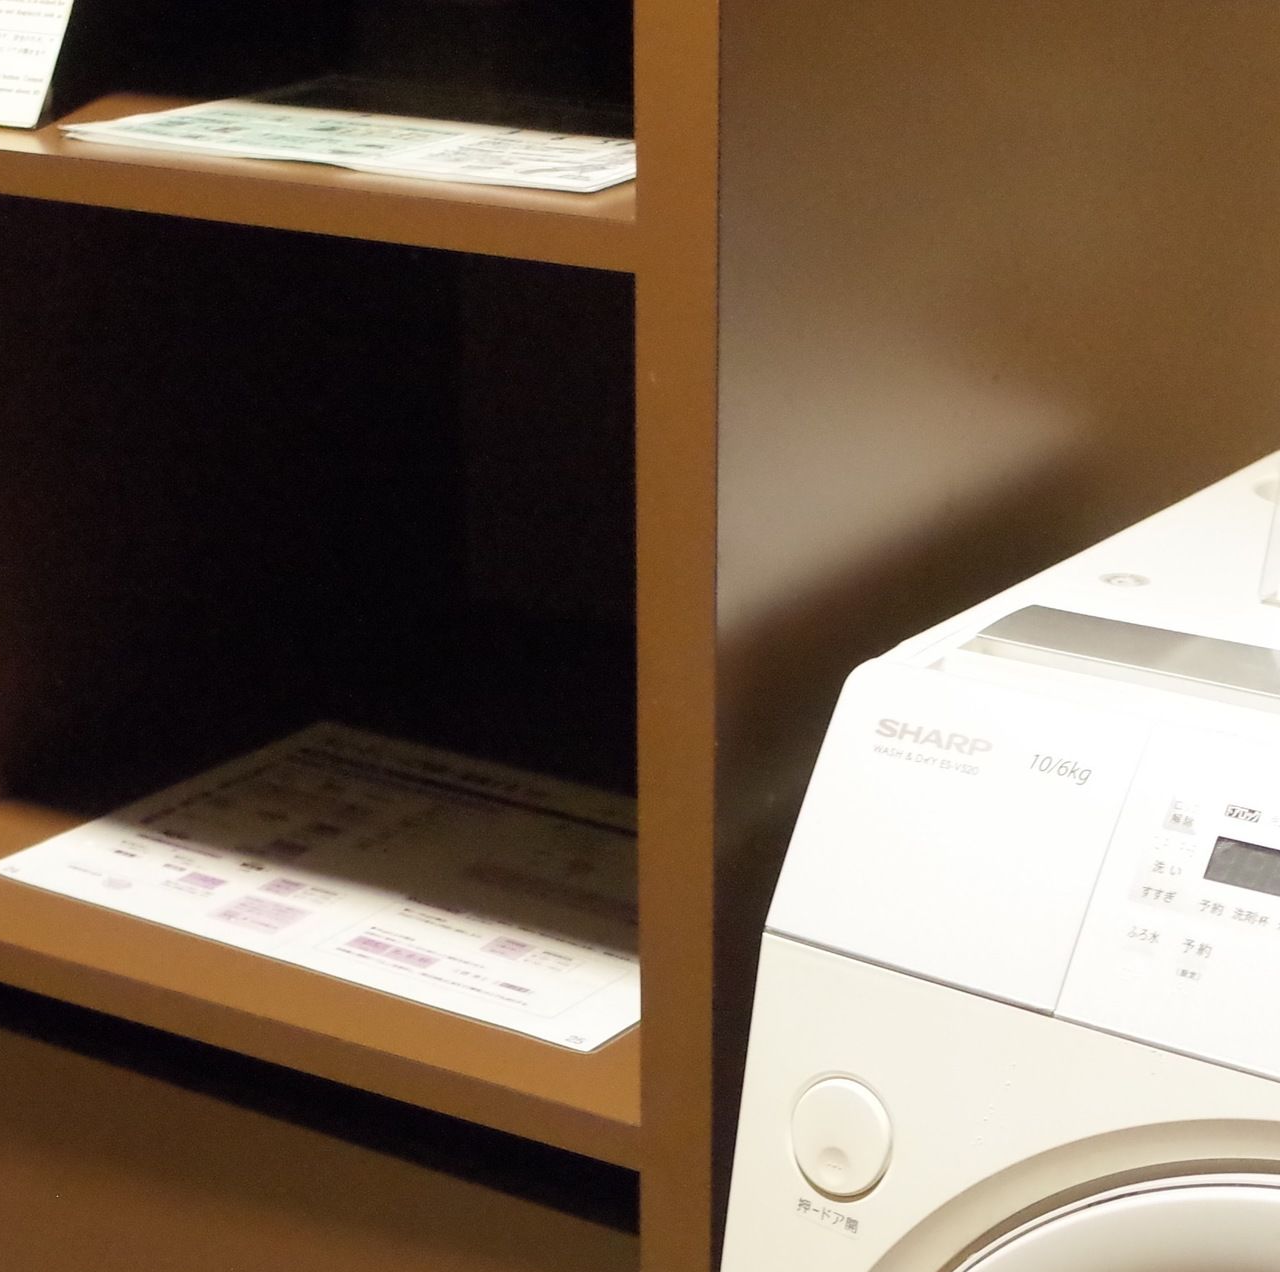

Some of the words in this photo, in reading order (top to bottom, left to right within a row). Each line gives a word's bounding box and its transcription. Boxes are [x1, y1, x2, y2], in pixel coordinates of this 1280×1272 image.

[875, 718, 994, 757] SHARP
[873, 743, 904, 761] WASH
[1028, 753, 1093, 786] 10/6kg
[1151, 860, 1182, 876] 洗い
[1141, 886, 1178, 904] すすぎ
[1198, 899, 1225, 917] 予約
[1127, 925, 1161, 944] ふろ水
[1181, 938, 1214, 959] 予約
